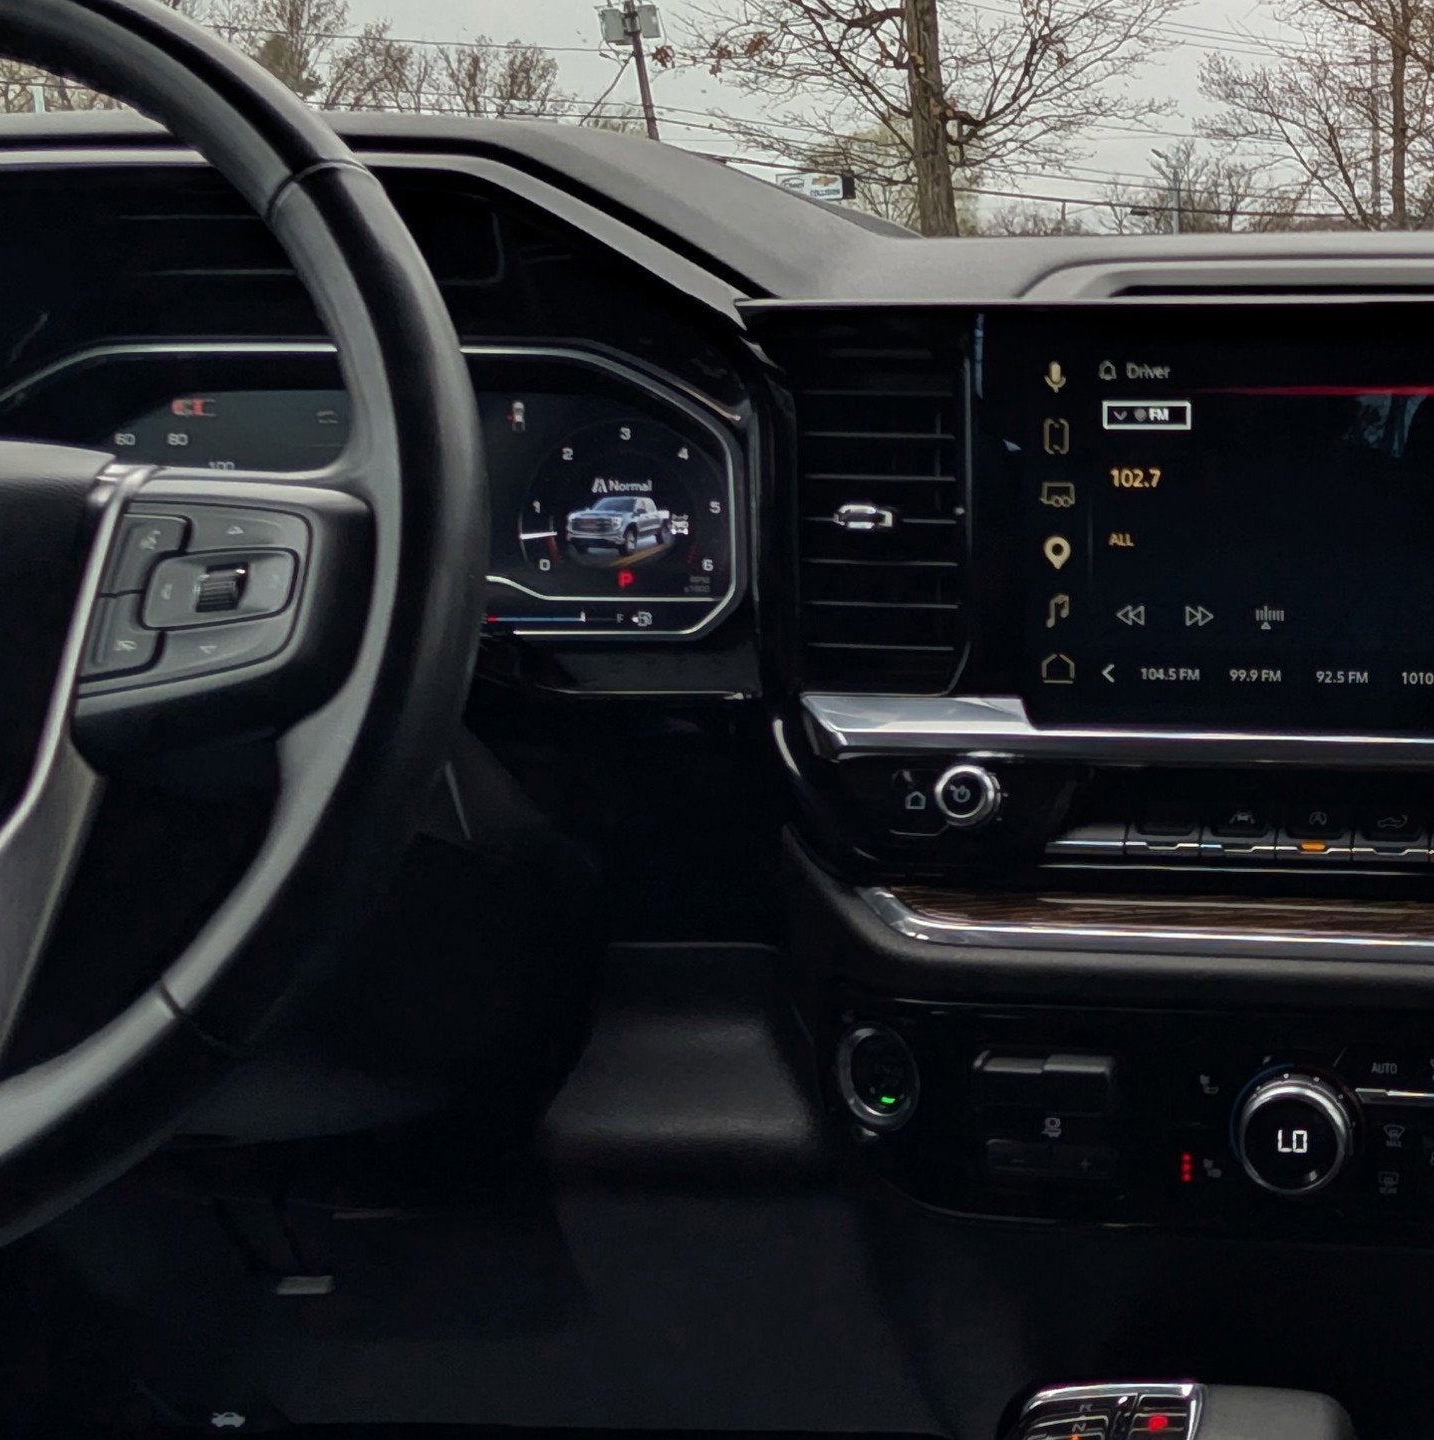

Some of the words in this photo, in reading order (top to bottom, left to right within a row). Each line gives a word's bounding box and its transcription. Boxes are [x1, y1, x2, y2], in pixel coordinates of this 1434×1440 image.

[1126, 362, 1171, 381] Driver
[1148, 407, 1170, 422] FM
[619, 426, 632, 441] 3
[561, 447, 574, 461] 2
[677, 446, 690, 461] 4
[607, 478, 653, 493] Normal
[1110, 468, 1161, 489] 102.7
[709, 500, 721, 514] 5
[1108, 531, 1135, 548] ALL
[702, 558, 715, 572] 6
[616, 569, 636, 589] P
[1139, 666, 1177, 682] 104.5
[1178, 666, 1201, 682] FM
[1228, 667, 1258, 683] 99.9
[1259, 668, 1283, 683] FM
[1315, 669, 1345, 684] 92.5
[1346, 670, 1370, 685] FM
[1400, 670, 1434, 686] 1010
[1370, 1061, 1399, 1075] AUTO
[1276, 1129, 1309, 1154] LO
